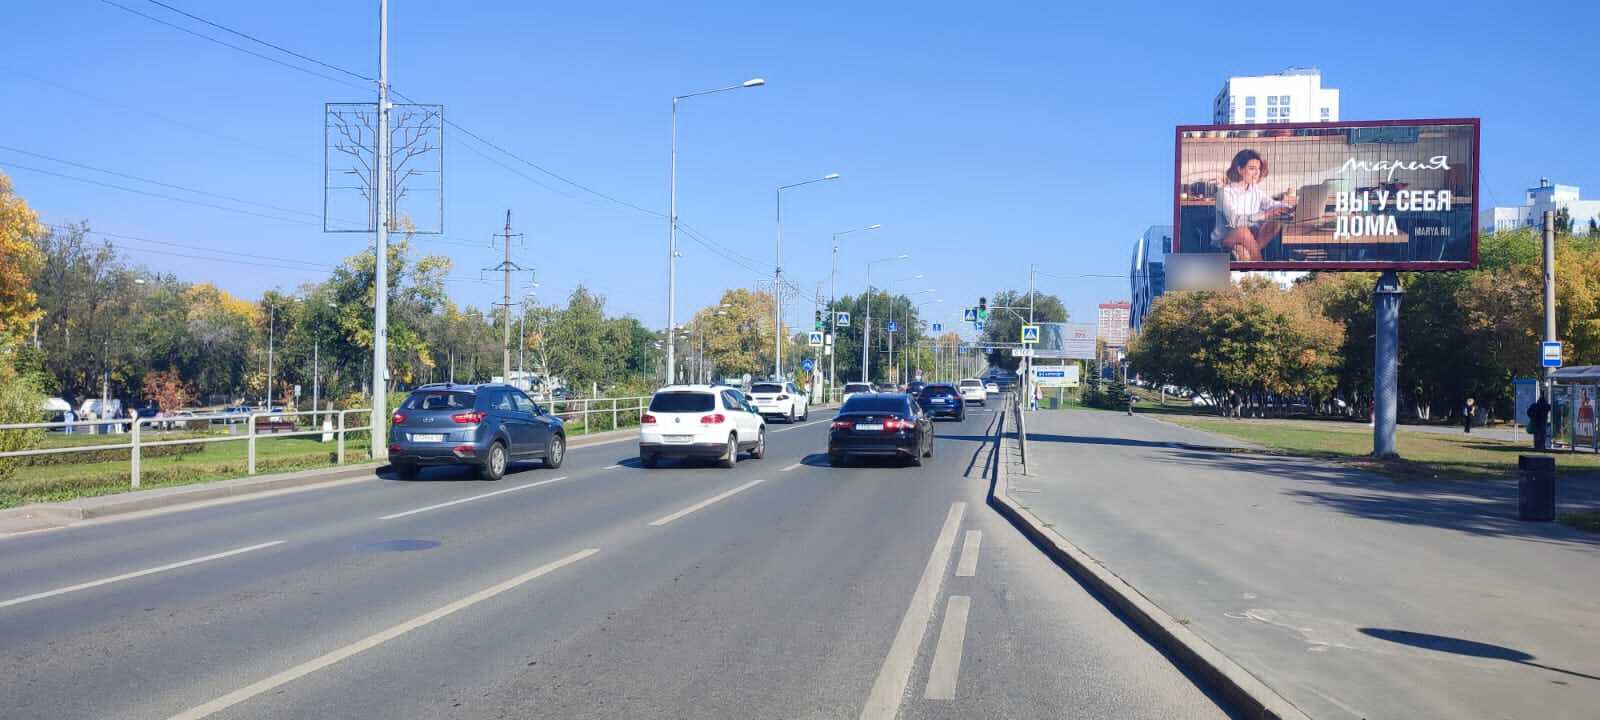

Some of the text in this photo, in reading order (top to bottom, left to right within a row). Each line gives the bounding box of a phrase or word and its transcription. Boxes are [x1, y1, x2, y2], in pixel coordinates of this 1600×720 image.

[1335, 189, 1451, 212] ВЫ У СЕБЯ
[1333, 214, 1399, 240] ДОМА
